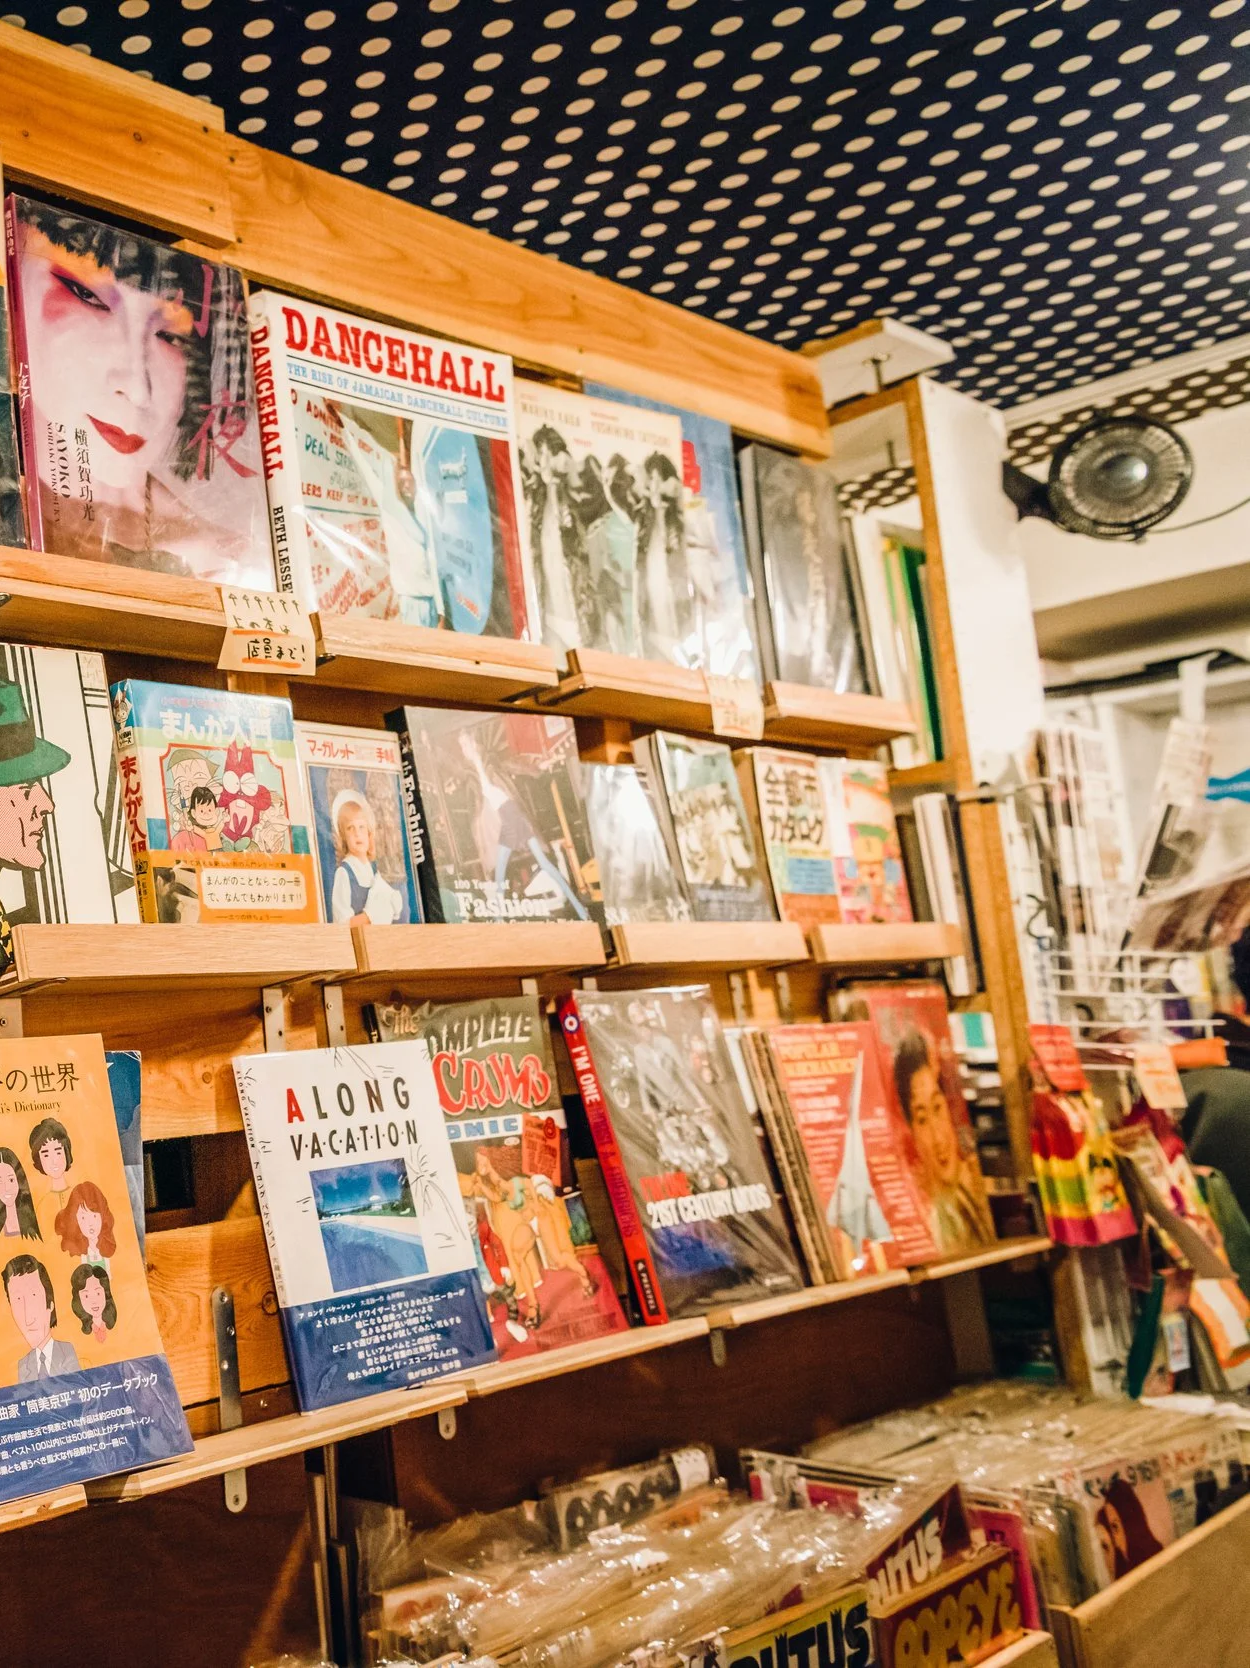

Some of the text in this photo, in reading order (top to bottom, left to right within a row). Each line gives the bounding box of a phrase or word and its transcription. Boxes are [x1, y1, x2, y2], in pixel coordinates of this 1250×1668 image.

[282, 307, 505, 403] DANCEHALL
[250, 326, 284, 480] DANCEHALL
[287, 362, 509, 428] THE RISE OF JAMAICAN DANCEHALL CULTURE
[54, 421, 71, 499] SAYOKO
[74, 427, 95, 522] 横須賀功光
[273, 506, 294, 593] BETH LESSE
[159, 708, 273, 749] まんが入門
[306, 739, 354, 760] マーガレット
[120, 756, 147, 854] まんが入門
[402, 774, 426, 865] Fashion
[206, 876, 301, 887] まんがのことならこの一冊
[454, 892, 550, 918] Fashion
[383, 1006, 421, 1034] The
[572, 1045, 591, 1071] I'M
[431, 1051, 551, 1115] CRUMB
[579, 1073, 601, 1105] ONE
[14, 1099, 62, 1116] Dictionary
[446, 1118, 519, 1140] OMIC
[646, 1200, 679, 1230] 21ST
[678, 1187, 734, 1226] CENTURY
